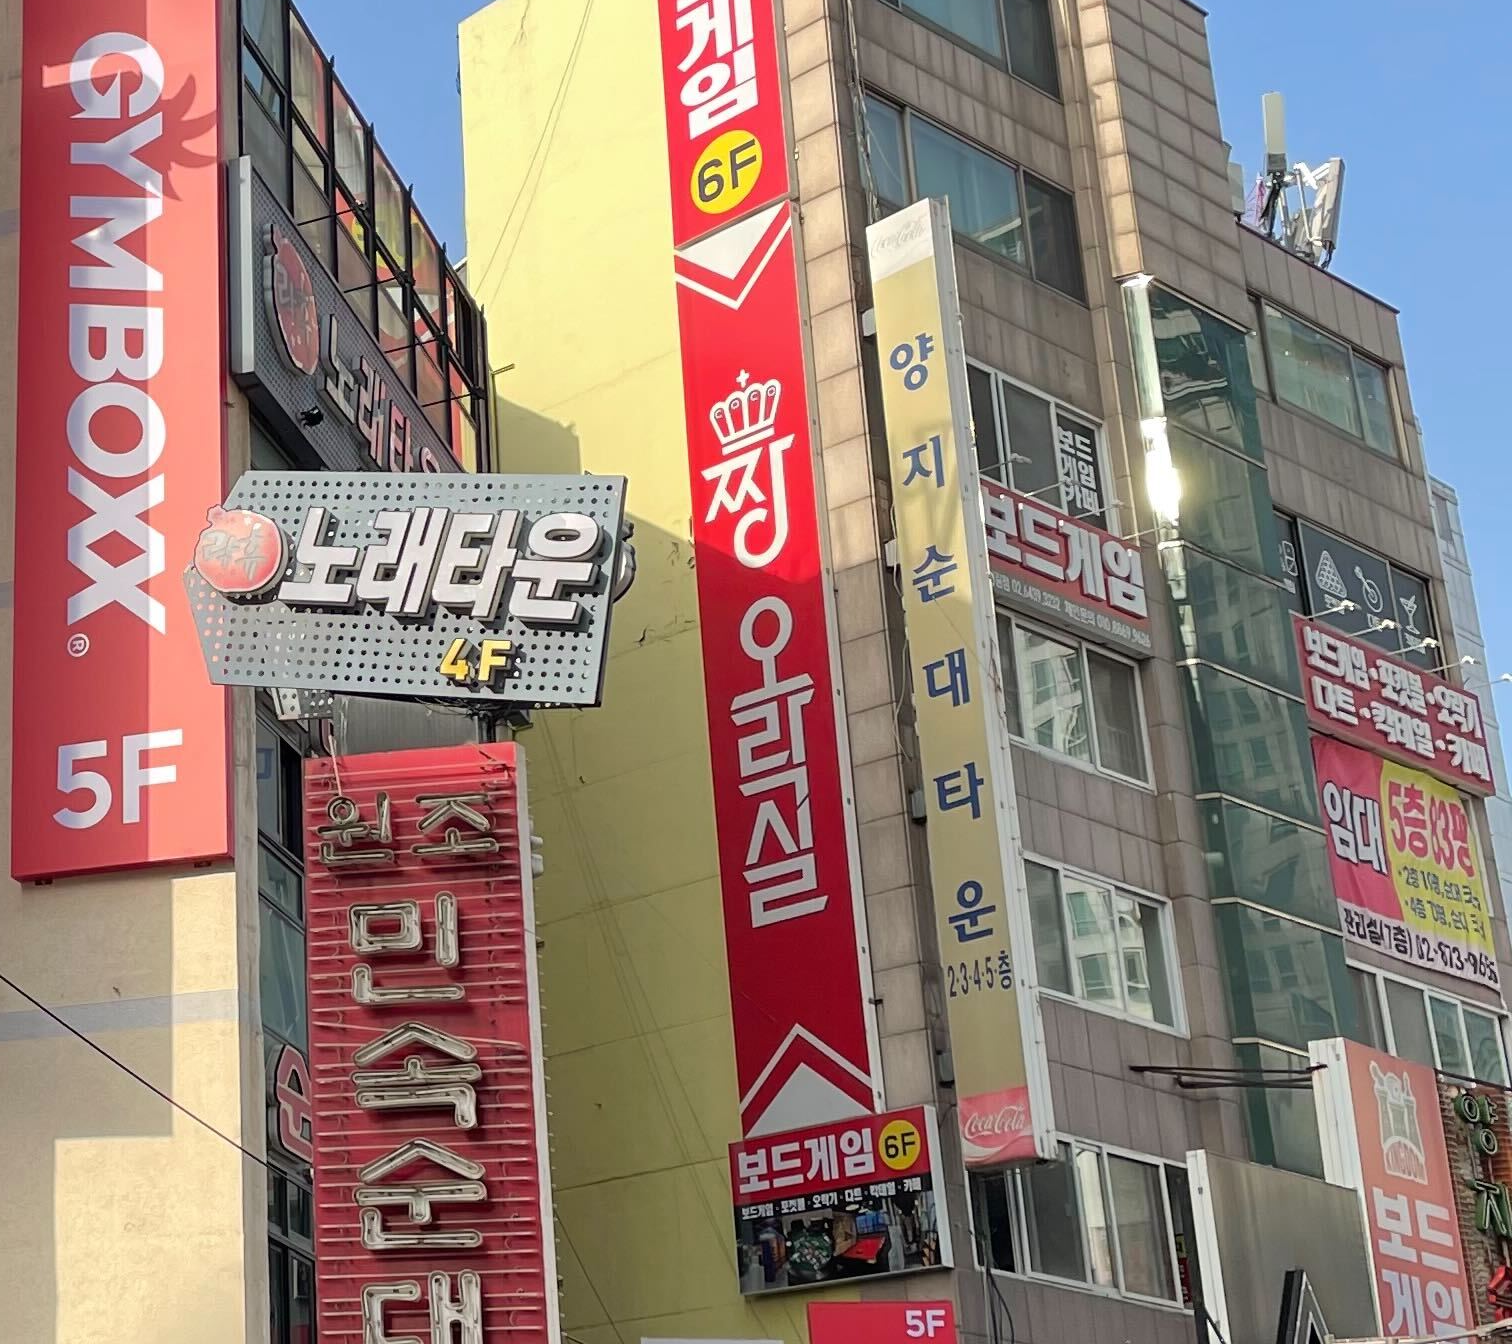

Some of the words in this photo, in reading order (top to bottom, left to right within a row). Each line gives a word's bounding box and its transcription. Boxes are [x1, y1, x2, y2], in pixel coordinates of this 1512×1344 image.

[696, 137, 757, 203] 6F
[63, 28, 168, 638] GYMBOXX
[278, 506, 603, 624] 노래타운
[983, 488, 1149, 619] 보드게임
[438, 637, 516, 684] 4F
[889, 331, 997, 944] 양지순대타운
[53, 727, 186, 833] 5F
[1388, 780, 1429, 858] 5층
[316, 789, 500, 866] 원조
[1322, 780, 1389, 876] 임대
[739, 1127, 876, 1195] 보드게임
[884, 1130, 917, 1160] 6F
[904, 1309, 946, 1338] 5F
